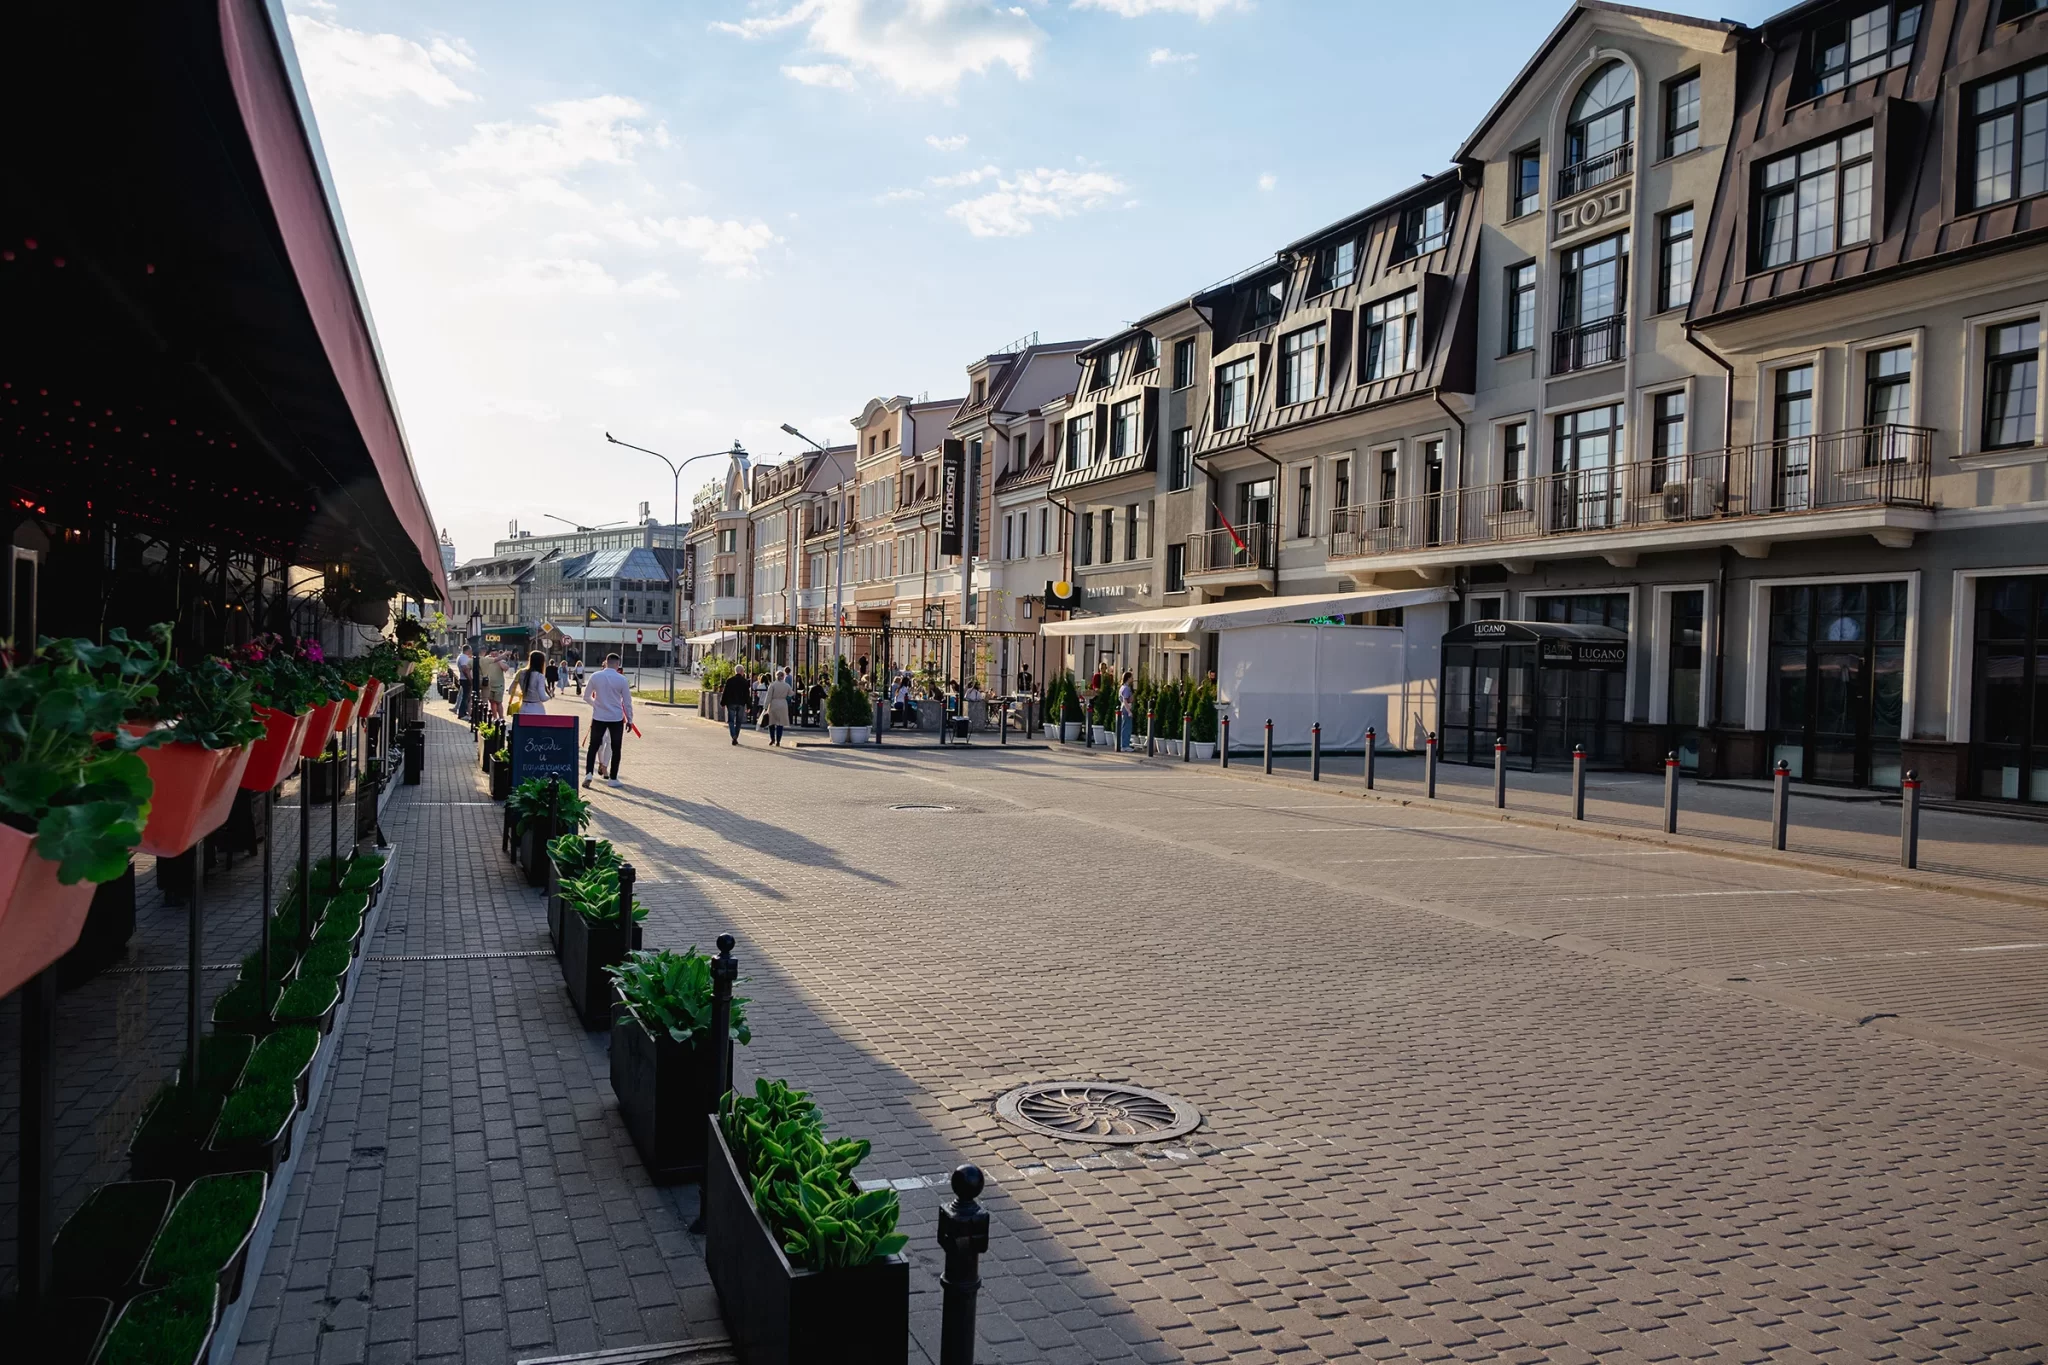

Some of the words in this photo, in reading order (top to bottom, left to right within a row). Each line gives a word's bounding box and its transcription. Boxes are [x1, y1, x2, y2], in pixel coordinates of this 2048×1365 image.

[943, 466, 956, 528] robinson
[685, 555, 693, 590] robinson
[1138, 583, 1148, 595] 24
[1474, 624, 1506, 633] LUGANO
[1543, 644, 1573, 655] BAZIS
[1579, 646, 1625, 659] LUGANO
[524, 737, 562, 752] Заходи
